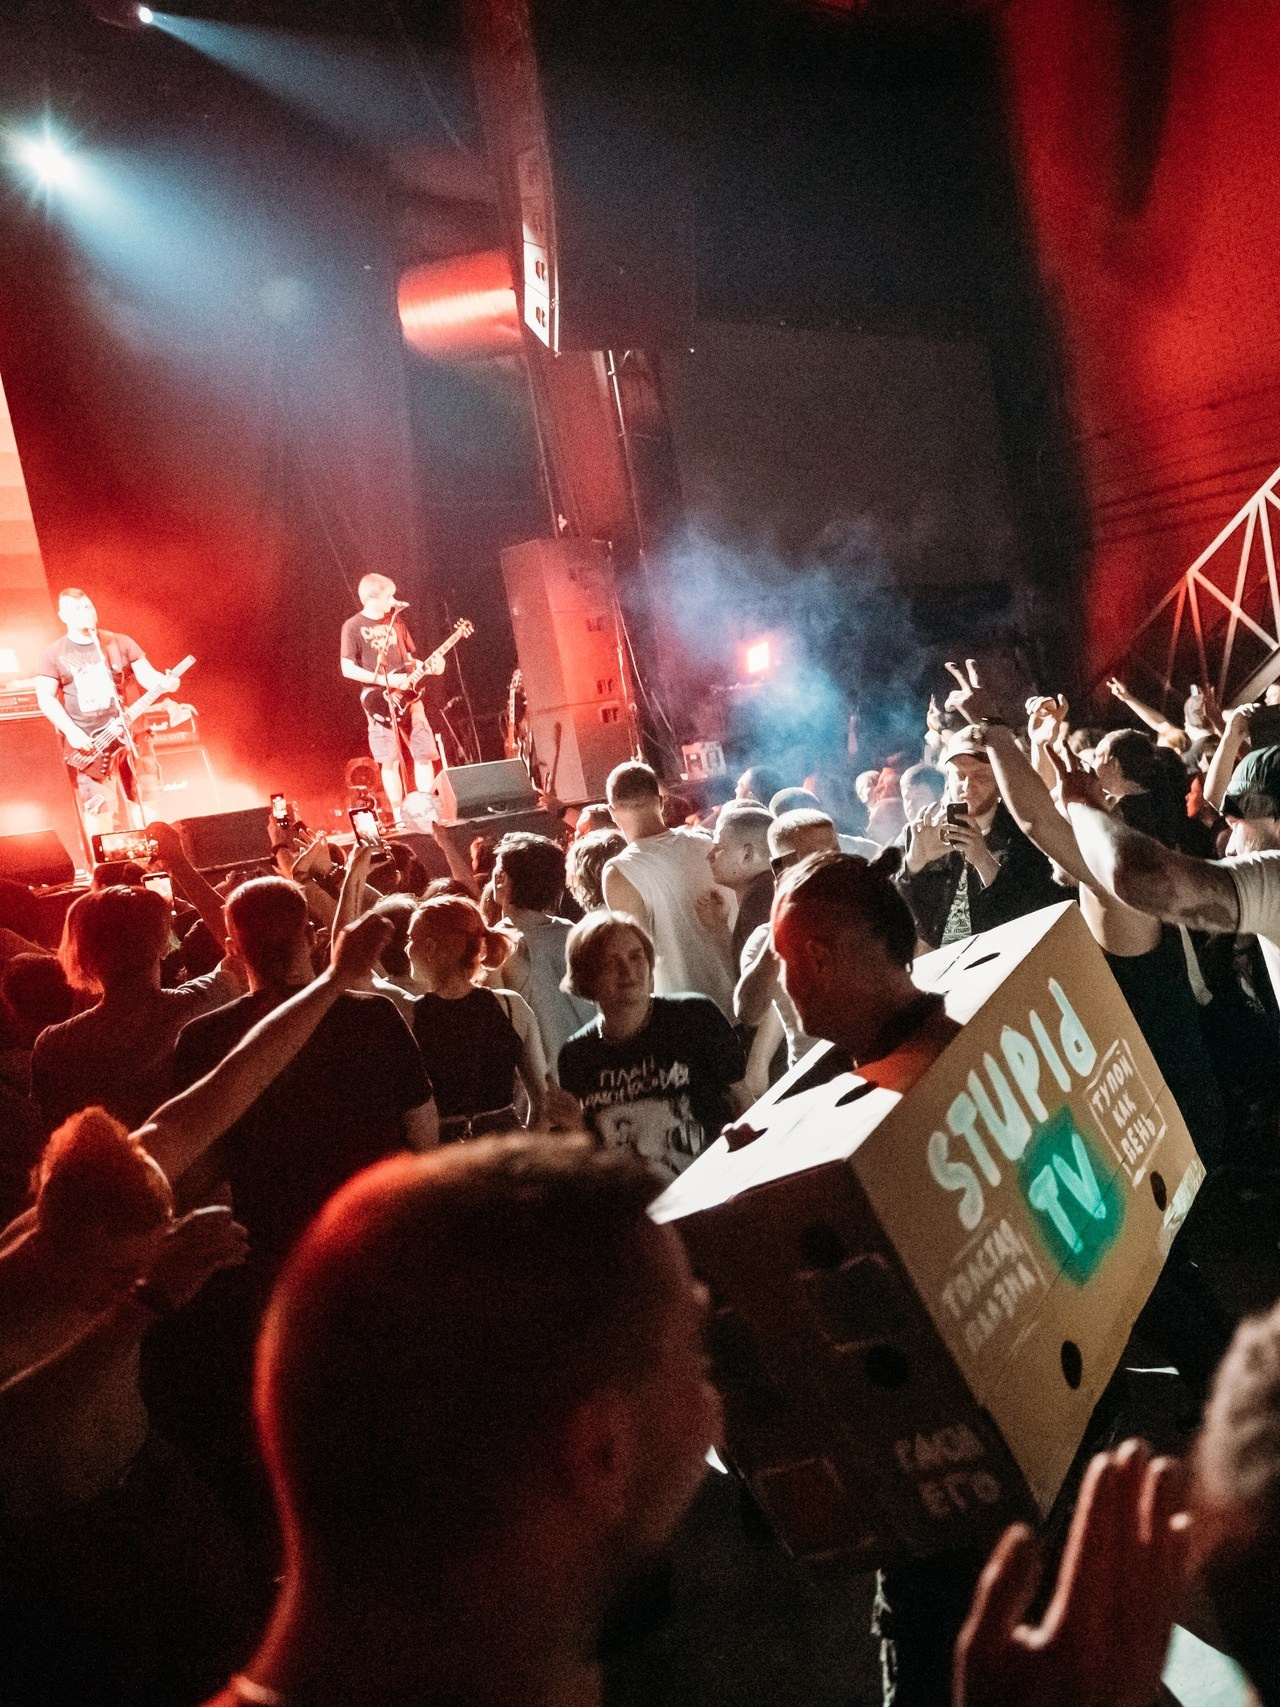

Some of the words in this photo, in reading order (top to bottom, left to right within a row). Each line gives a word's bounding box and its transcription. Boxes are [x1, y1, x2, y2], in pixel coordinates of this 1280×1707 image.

[1092, 1050, 1133, 1115] ТУПОЙ
[1112, 1089, 1137, 1129] КАК
[1029, 1133, 1107, 1252] TV
